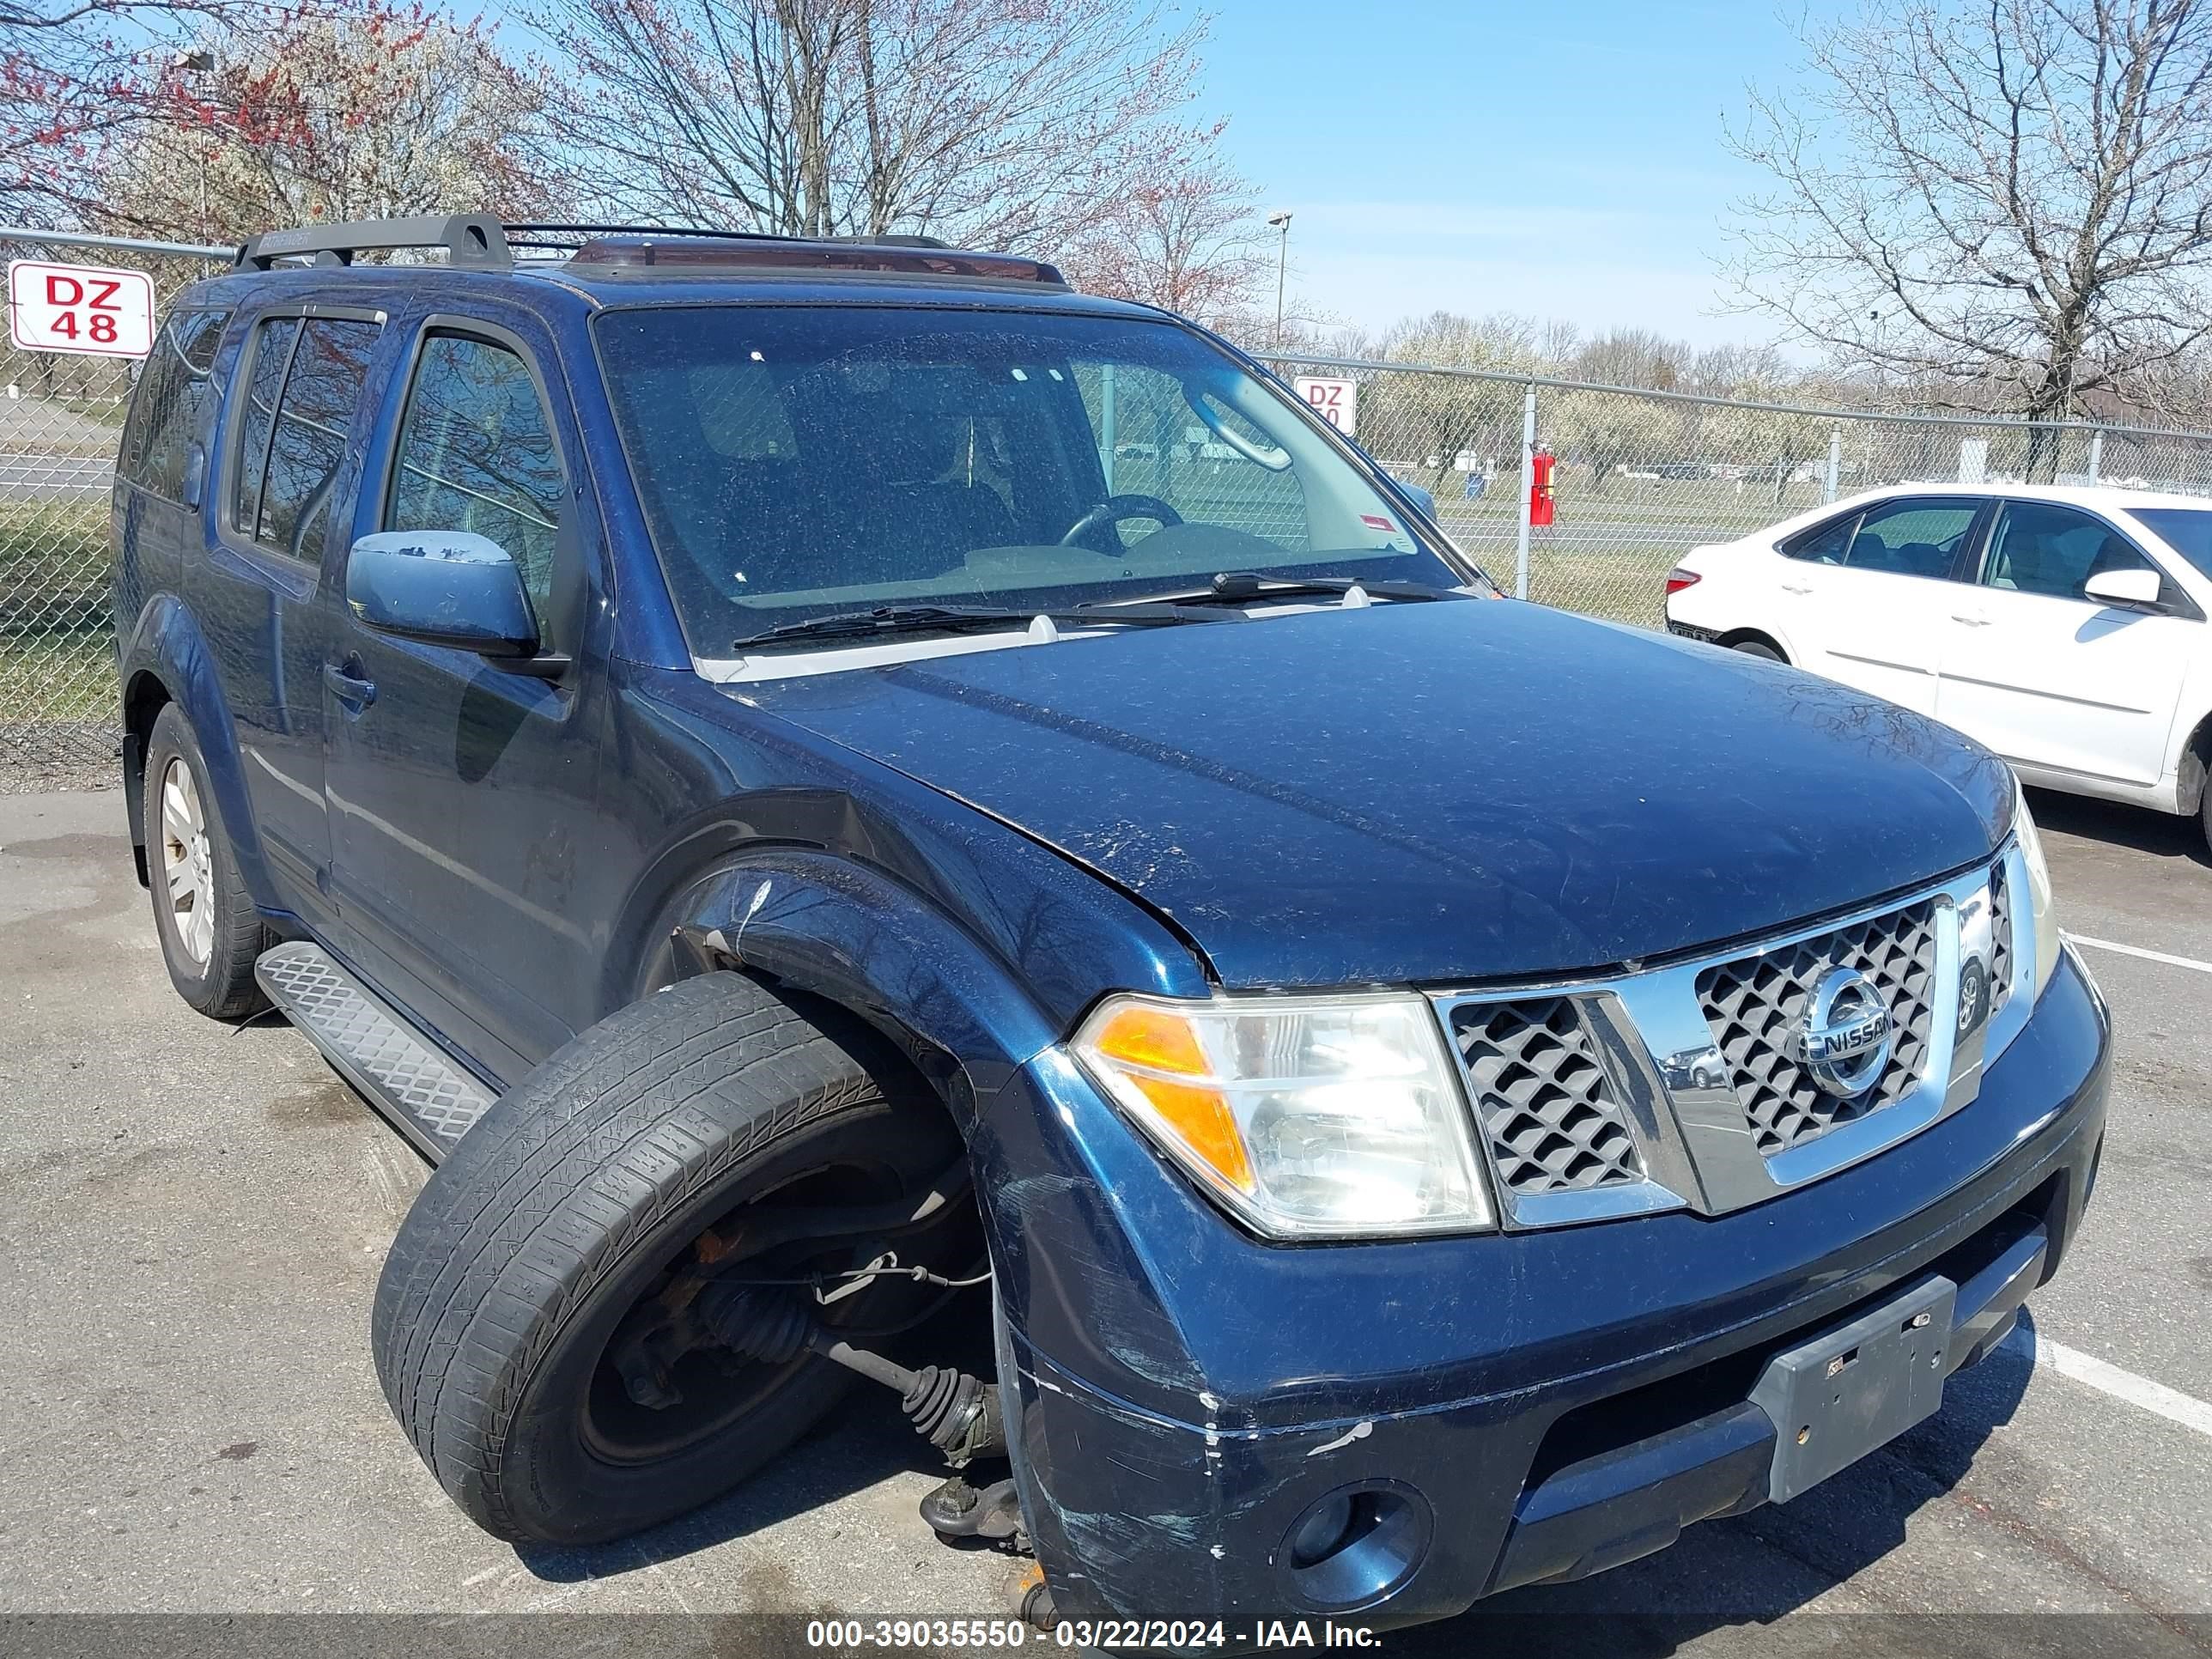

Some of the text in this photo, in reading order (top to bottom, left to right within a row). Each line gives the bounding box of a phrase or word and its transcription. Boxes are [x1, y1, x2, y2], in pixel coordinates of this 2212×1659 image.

[259, 232, 312, 248] PATHFINDER
[46, 275, 122, 311] DZ
[51, 311, 118, 343] 48
[1310, 385, 1342, 406] DZ
[1314, 408, 1340, 427] 0
[1824, 1013, 1892, 1055] NISSAN
